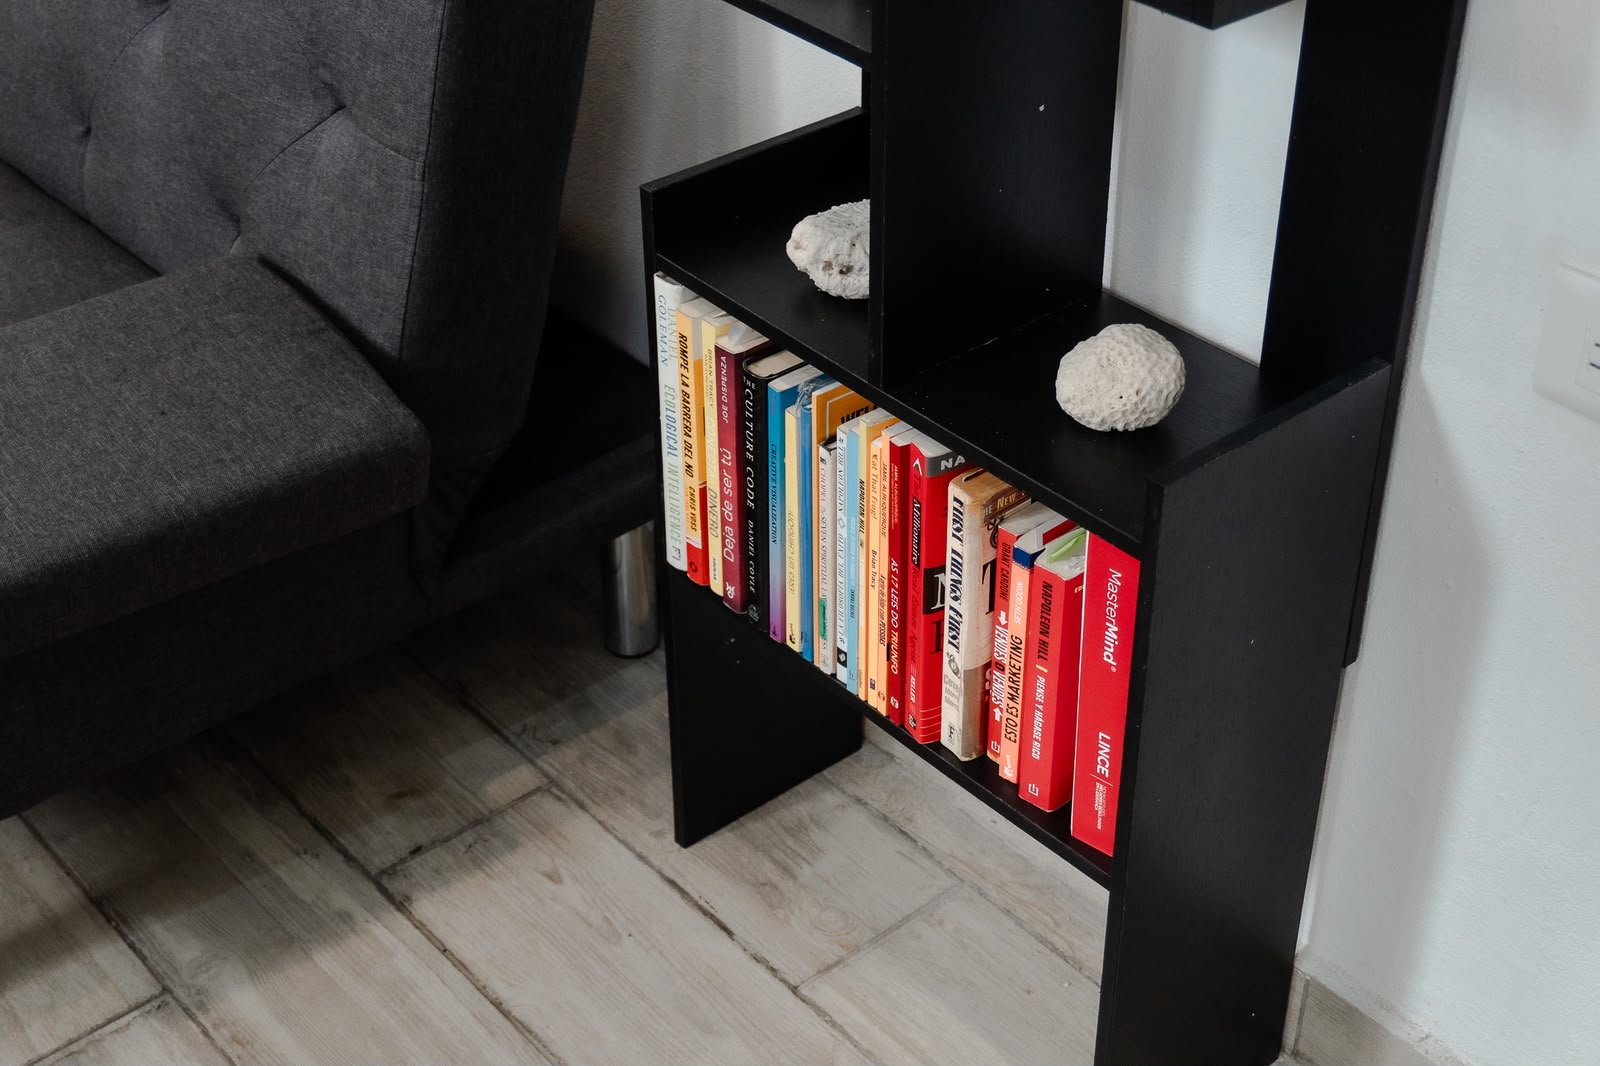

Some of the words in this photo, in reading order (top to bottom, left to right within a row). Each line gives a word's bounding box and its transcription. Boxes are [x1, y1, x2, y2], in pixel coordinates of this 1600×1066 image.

[658, 295, 668, 367] GOLEMAN
[679, 333, 689, 372] ROMPE
[681, 374, 689, 387] LA
[743, 376, 755, 389] THE
[664, 385, 677, 457] ECOLOGICAL
[682, 392, 693, 438] BARRERA
[745, 389, 754, 461] CULTURE
[684, 440, 692, 459] DEL
[720, 448, 731, 466] tú
[685, 462, 693, 477] NO
[723, 469, 733, 496] ser
[746, 467, 754, 509] CODE
[997, 493, 1018, 510] NEW
[668, 463, 681, 543] INTELLIGENCE
[708, 488, 718, 538] DINERO
[723, 501, 733, 522] de
[870, 495, 878, 520] Frog!
[912, 498, 921, 565] Millionaire
[952, 495, 965, 546] FIRST
[724, 526, 734, 562] Deja
[1001, 542, 1011, 567] GRANT
[788, 557, 794, 569] UN
[891, 558, 898, 573] AS
[891, 575, 898, 586] 17
[911, 566, 919, 593] Real
[949, 548, 964, 606] THINGS
[999, 568, 1009, 602] CARDONE
[891, 610, 898, 628] DO
[1039, 581, 1053, 635] NAPOLEON
[948, 605, 963, 653] FIRST
[994, 624, 1008, 663] VENDES
[1038, 637, 1048, 661] HILL
[995, 662, 1005, 672] O
[1006, 634, 1023, 705] MARKETING
[990, 670, 1005, 708] VENDES
[1036, 675, 1045, 702] PIENSE
[1005, 704, 1019, 718] ES
[1004, 718, 1018, 744] ESTO
[1032, 710, 1044, 741] HÁGASE
[1031, 741, 1041, 760] RICO
[1097, 732, 1111, 778] LINCE
